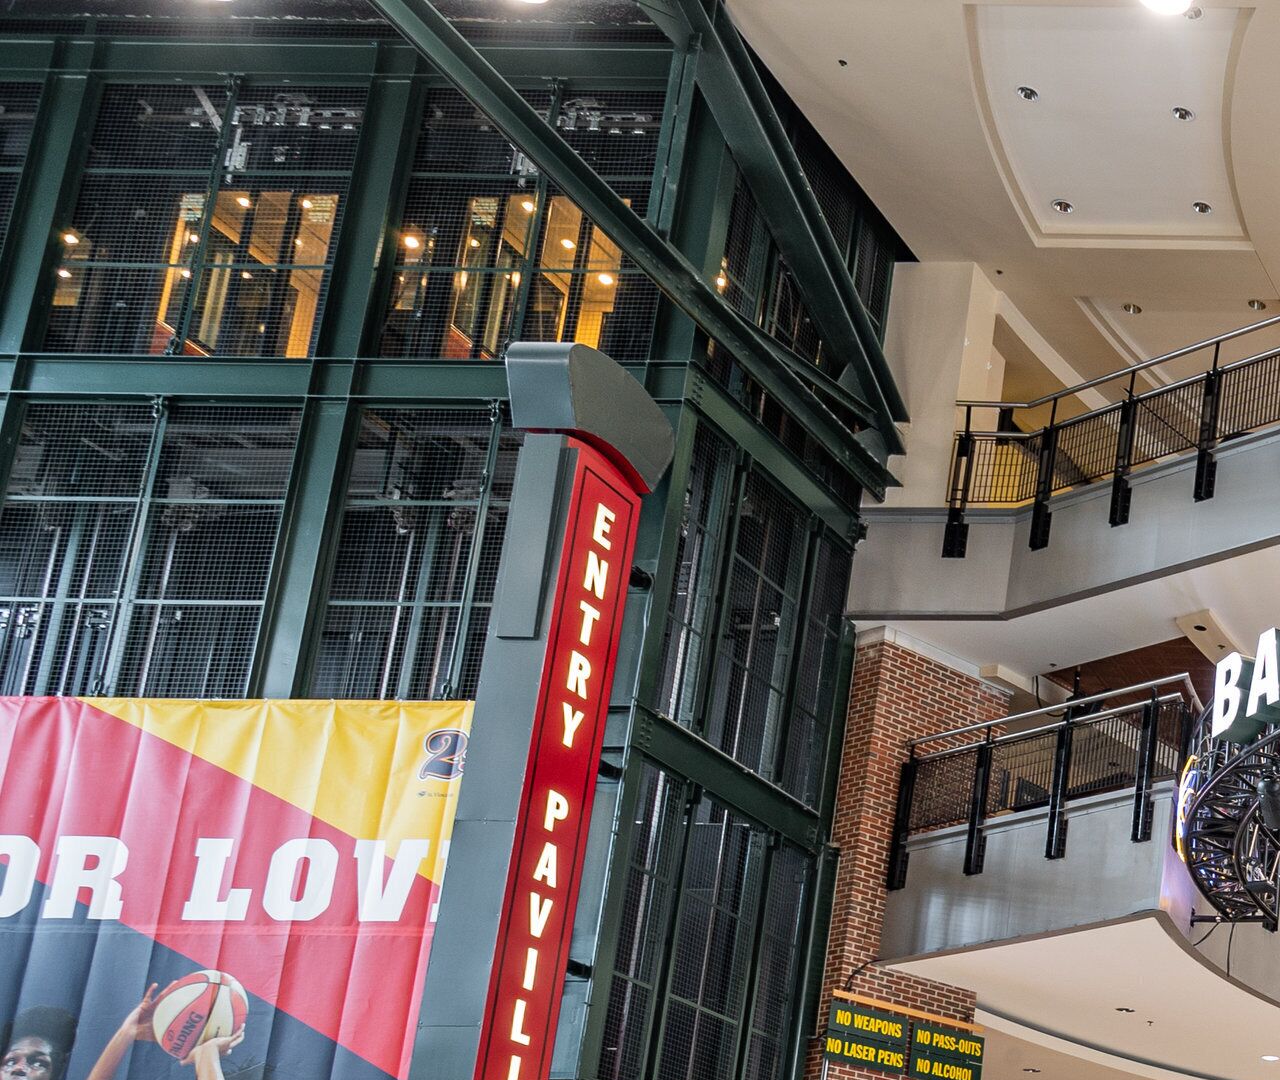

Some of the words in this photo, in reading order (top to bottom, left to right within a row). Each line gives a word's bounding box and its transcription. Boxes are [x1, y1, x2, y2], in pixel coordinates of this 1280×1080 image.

[562, 503, 616, 748] ENTRY
[181, 838, 451, 922] LOV
[836, 1010, 851, 1025] NO
[854, 1015, 902, 1038] WEAPONS
[826, 1038, 841, 1054] NO
[844, 1042, 875, 1061] LASER
[877, 1050, 904, 1068] PENS
[916, 1029, 931, 1045] NO
[932, 1032, 982, 1057] PASS-OUTS
[916, 1058, 930, 1073] NO
